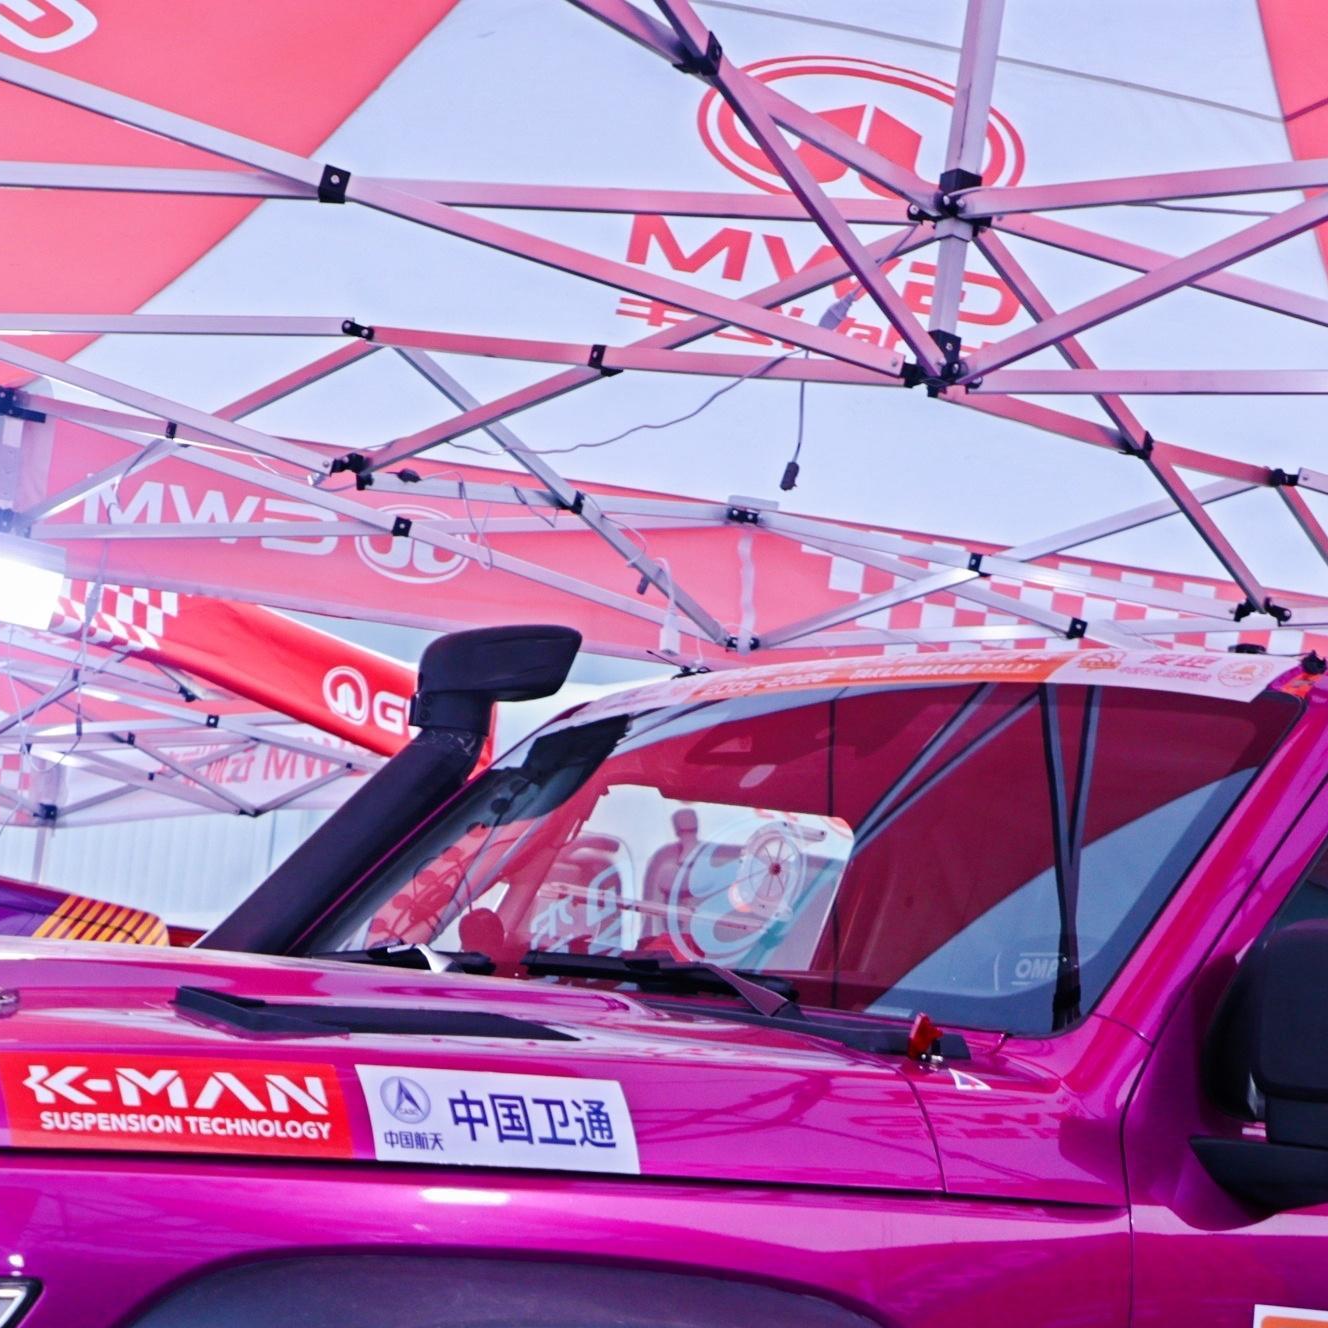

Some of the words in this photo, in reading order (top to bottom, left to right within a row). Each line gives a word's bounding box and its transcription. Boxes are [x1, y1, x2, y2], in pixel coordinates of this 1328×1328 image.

[23, 1064, 329, 1115] K-MAN
[40, 1110, 183, 1136] SUSPENSION
[185, 1115, 332, 1141] TECHNOLOGY
[447, 1089, 617, 1149] 中国卫通
[384, 1129, 445, 1151] 中国航天
